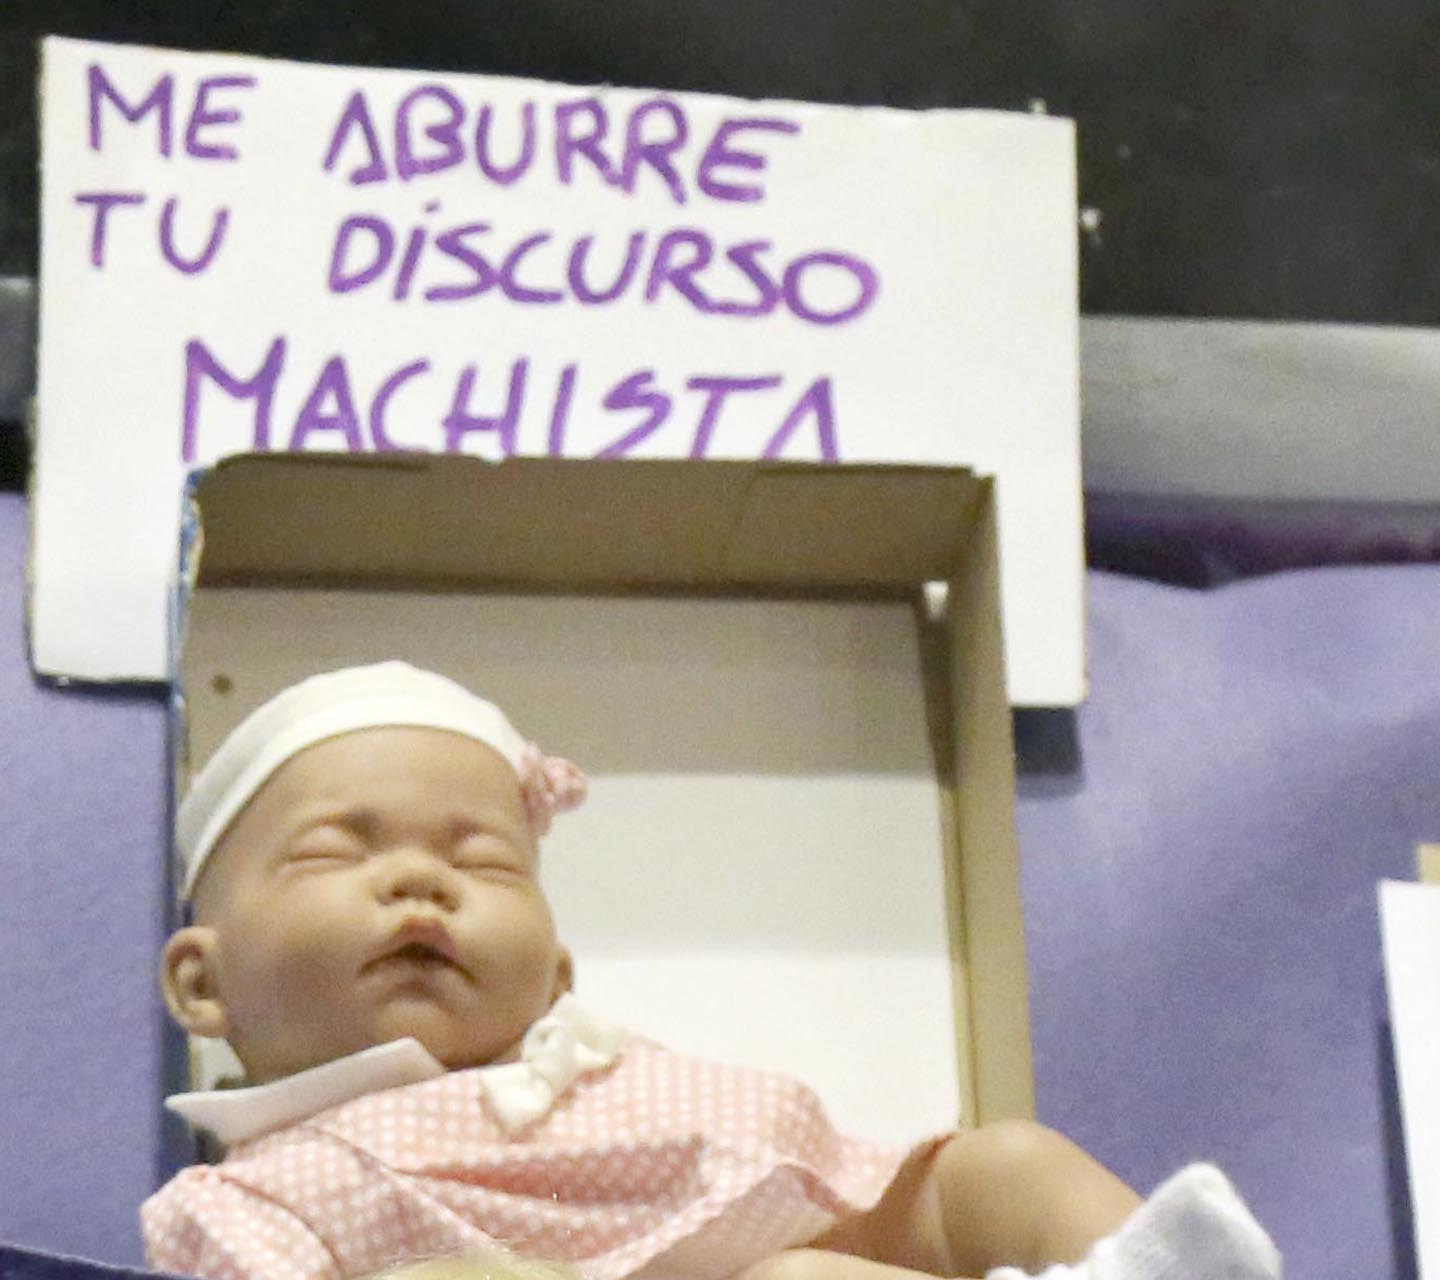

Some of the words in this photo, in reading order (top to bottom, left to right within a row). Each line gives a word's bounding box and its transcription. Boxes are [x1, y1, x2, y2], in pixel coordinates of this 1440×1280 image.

[86, 61, 258, 163] ME
[321, 84, 801, 203] ABURRE
[74, 192, 231, 276] TU
[181, 337, 842, 462] MACHISTA
